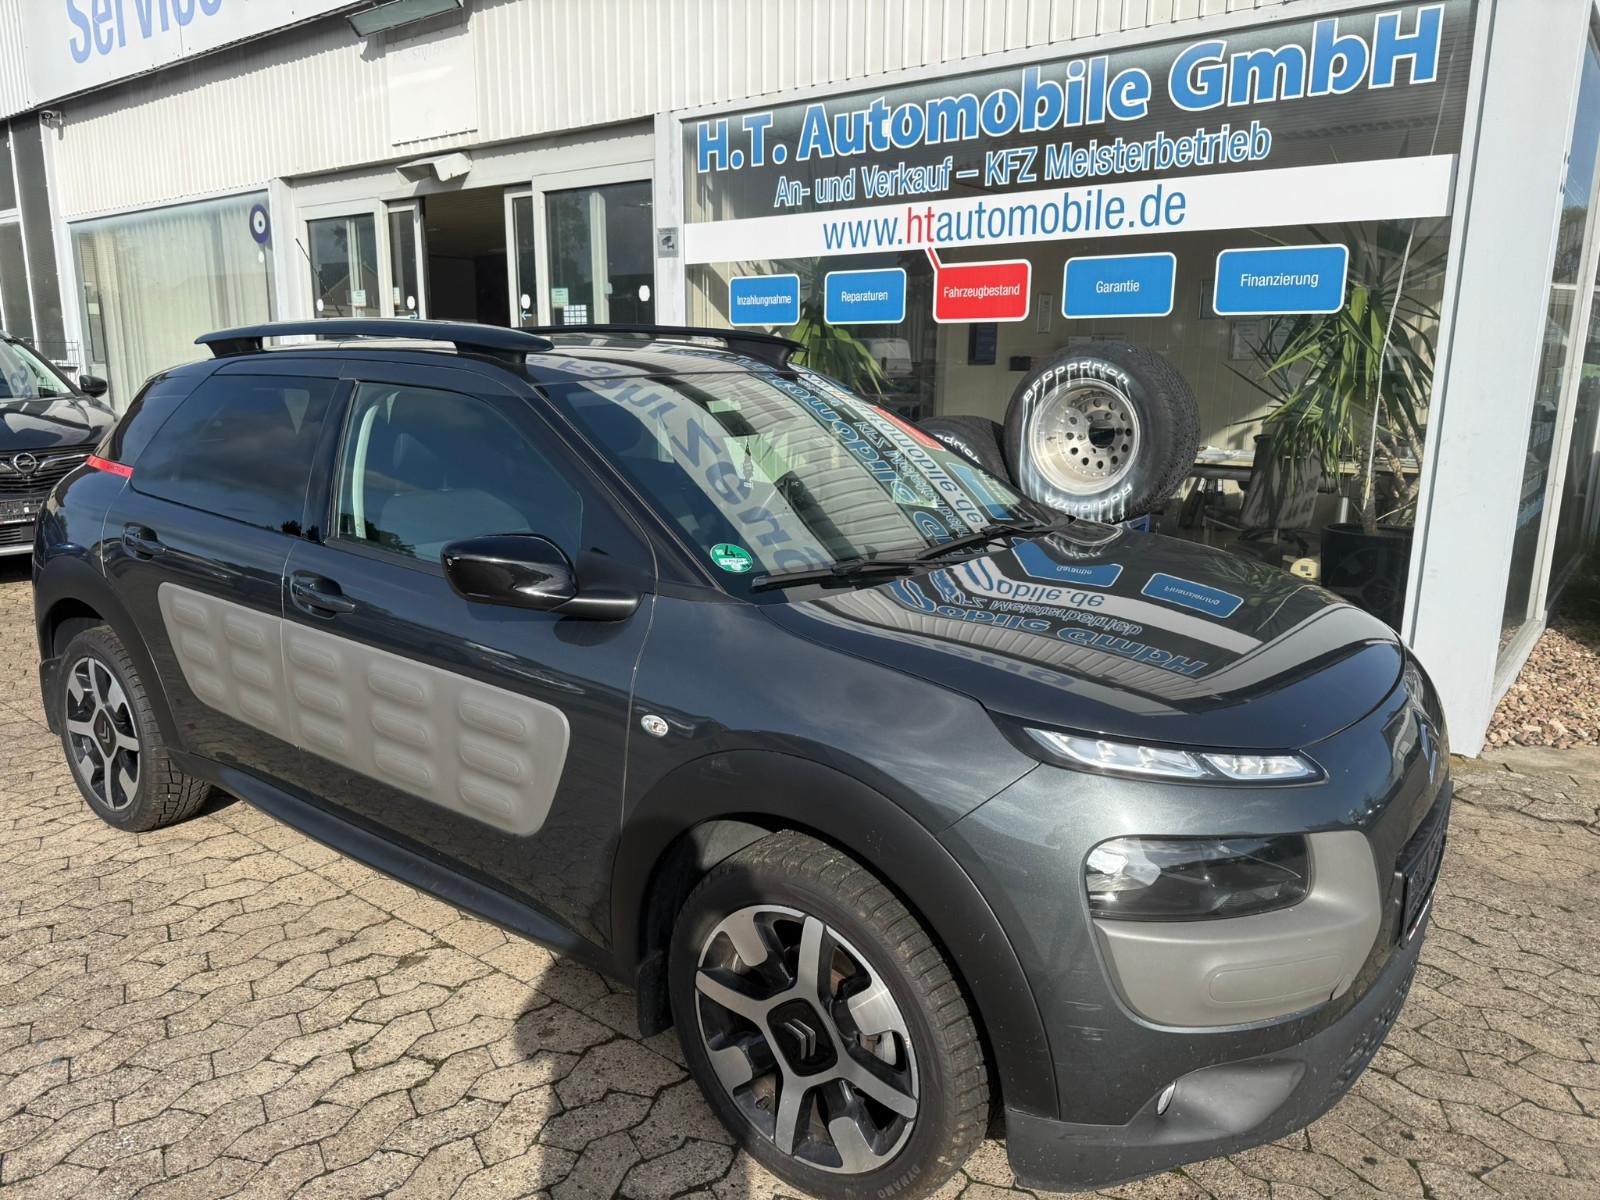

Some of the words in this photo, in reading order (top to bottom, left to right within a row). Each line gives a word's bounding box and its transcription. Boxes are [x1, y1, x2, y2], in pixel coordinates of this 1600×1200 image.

[697, 112, 788, 173] H.T.
[796, 55, 1151, 161] Automobile
[1168, 3, 1445, 112] GmbH
[774, 176, 810, 208] An-
[815, 167, 856, 204] und
[861, 156, 953, 199] Verkauf
[984, 147, 1039, 187] KFZ
[1045, 120, 1272, 181] Meisterbetrieb
[823, 184, 1186, 250] www.htautomobile.de
[1096, 280, 1140, 294] Garantie
[1240, 272, 1319, 288] Finanzierung
[841, 290, 888, 304] Reparaturen
[943, 283, 1020, 299] Fahrzeugbestand
[737, 294, 792, 306] Inzahlungnahme
[1023, 360, 1130, 401] BFGoodrich
